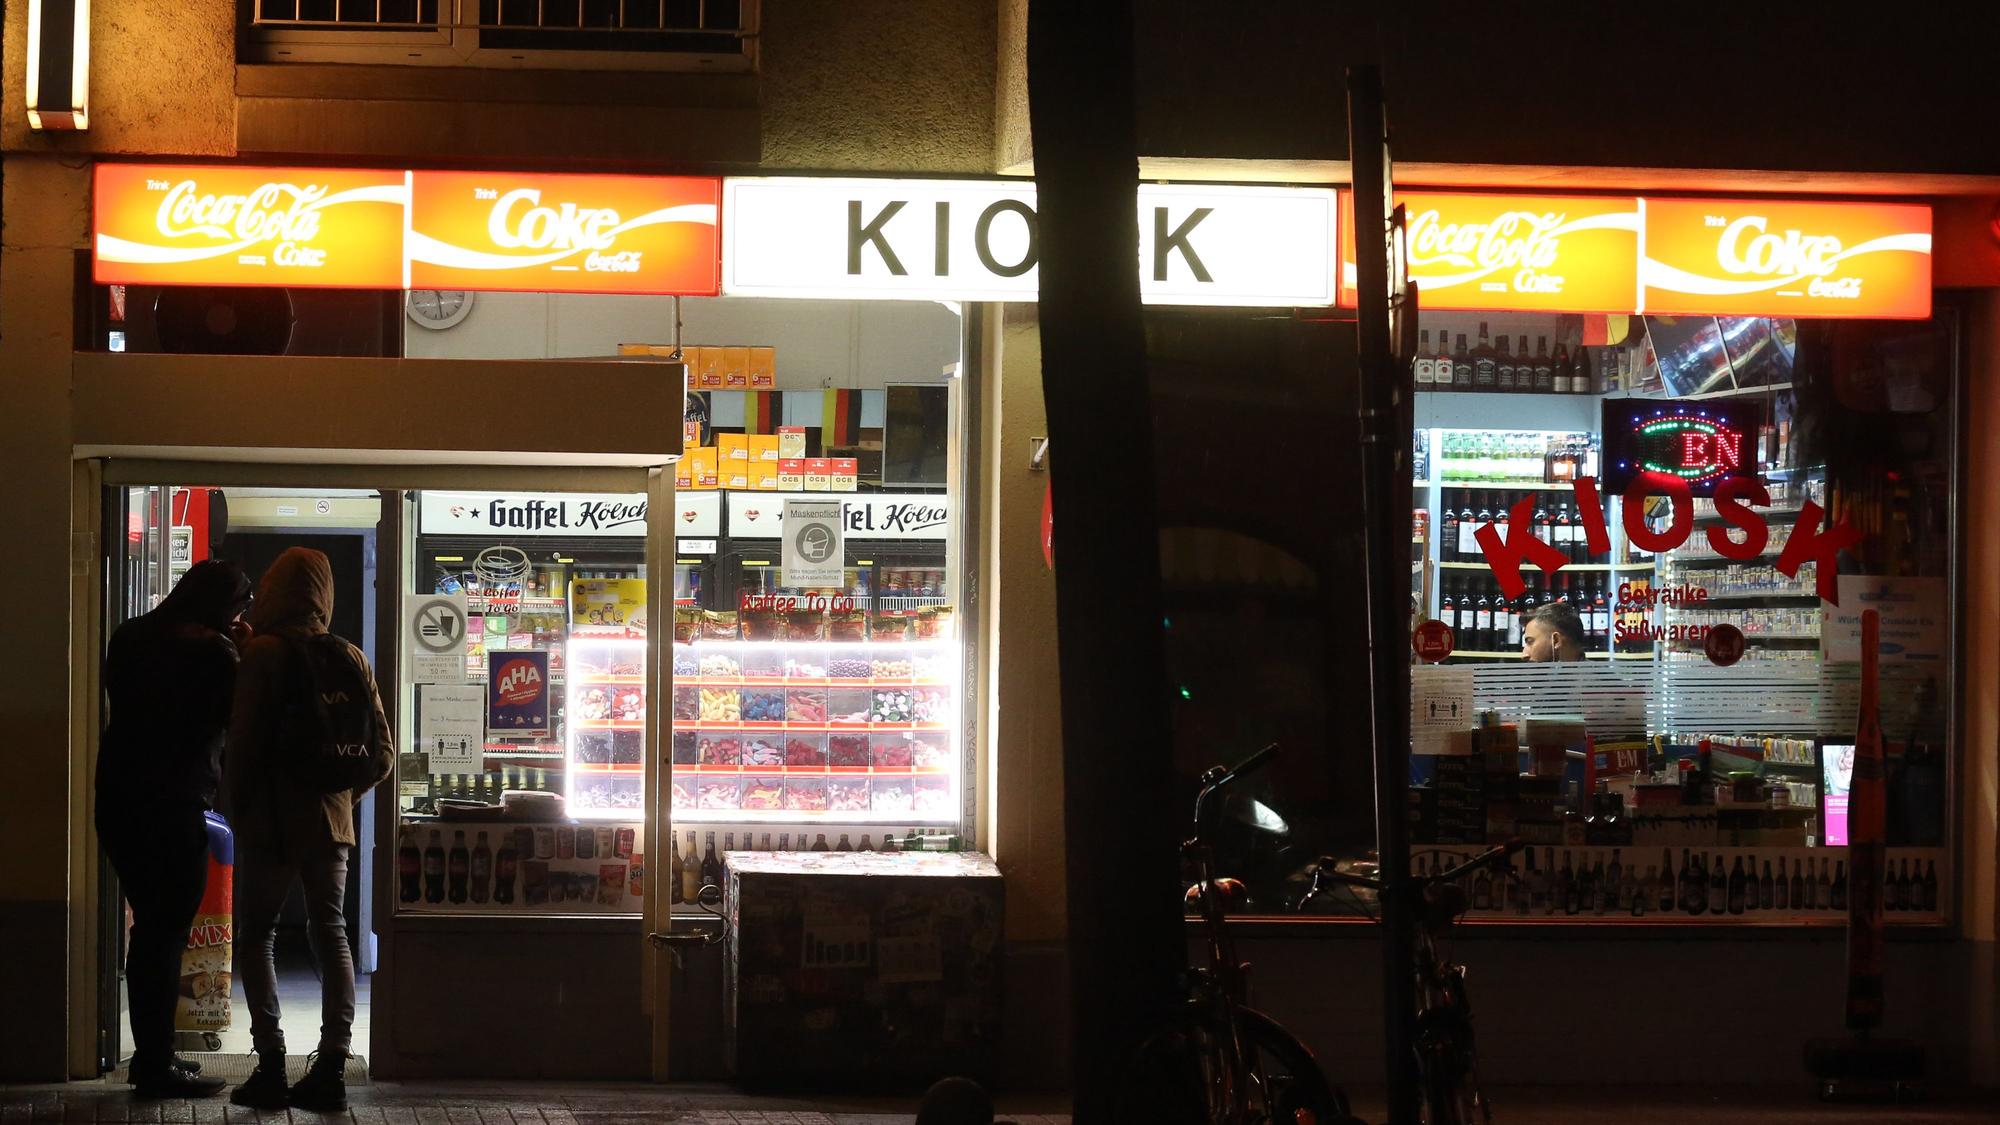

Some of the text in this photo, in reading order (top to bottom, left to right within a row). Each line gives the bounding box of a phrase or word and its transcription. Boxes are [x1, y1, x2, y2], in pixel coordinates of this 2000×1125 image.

[146, 180, 170, 190] Trink
[474, 188, 497, 199] Trink
[156, 180, 328, 241] Coca-Cola
[488, 188, 620, 250] Coke
[847, 199, 1215, 283] KIOK
[1406, 210, 1565, 268] Coca-Cola
[1717, 216, 1842, 276] Coke
[490, 499, 568, 530] Gaffel
[791, 509, 841, 518] Maskenpflicht
[843, 503, 875, 531] fel
[1474, 472, 1864, 606] KIOSK
[484, 588, 520, 600] Coffee
[741, 591, 854, 614] Kaffee To Go
[1618, 583, 1708, 605] Getränke
[488, 604, 519, 614] To Go
[1614, 620, 1712, 641] Süßwaren
[499, 666, 541, 694] AHA
[1617, 750, 1637, 768] L&M
